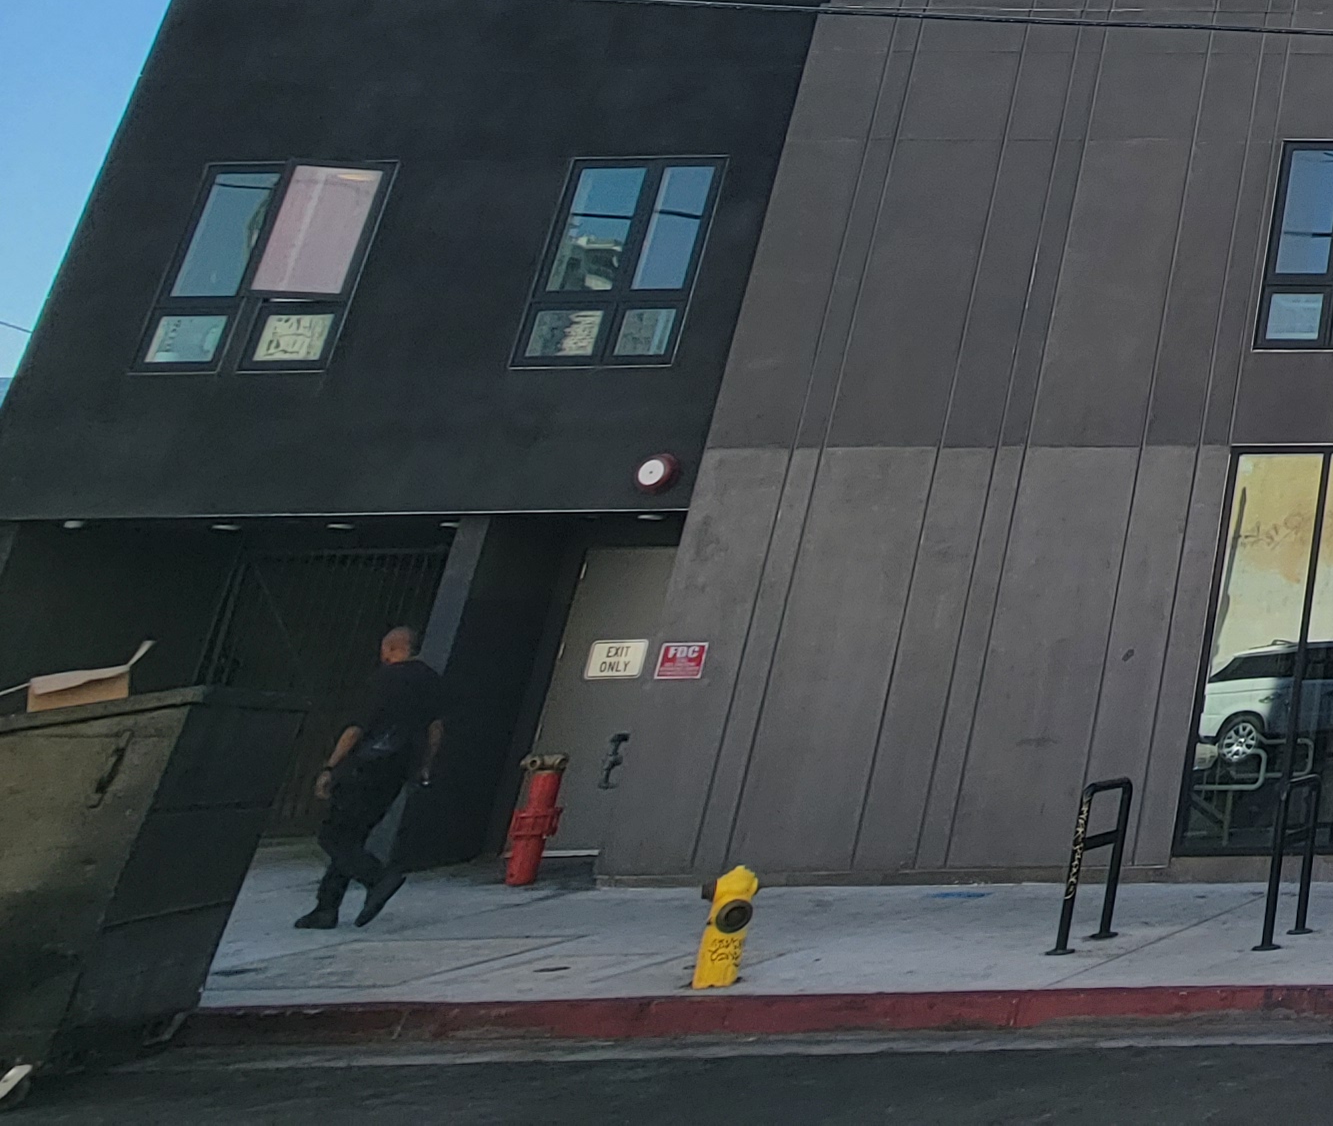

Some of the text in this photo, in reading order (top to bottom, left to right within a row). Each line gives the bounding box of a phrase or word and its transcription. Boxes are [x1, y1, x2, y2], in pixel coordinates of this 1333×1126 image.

[605, 645, 632, 658] EXIT
[667, 646, 700, 658] FDC
[599, 661, 632, 673] ONLY
